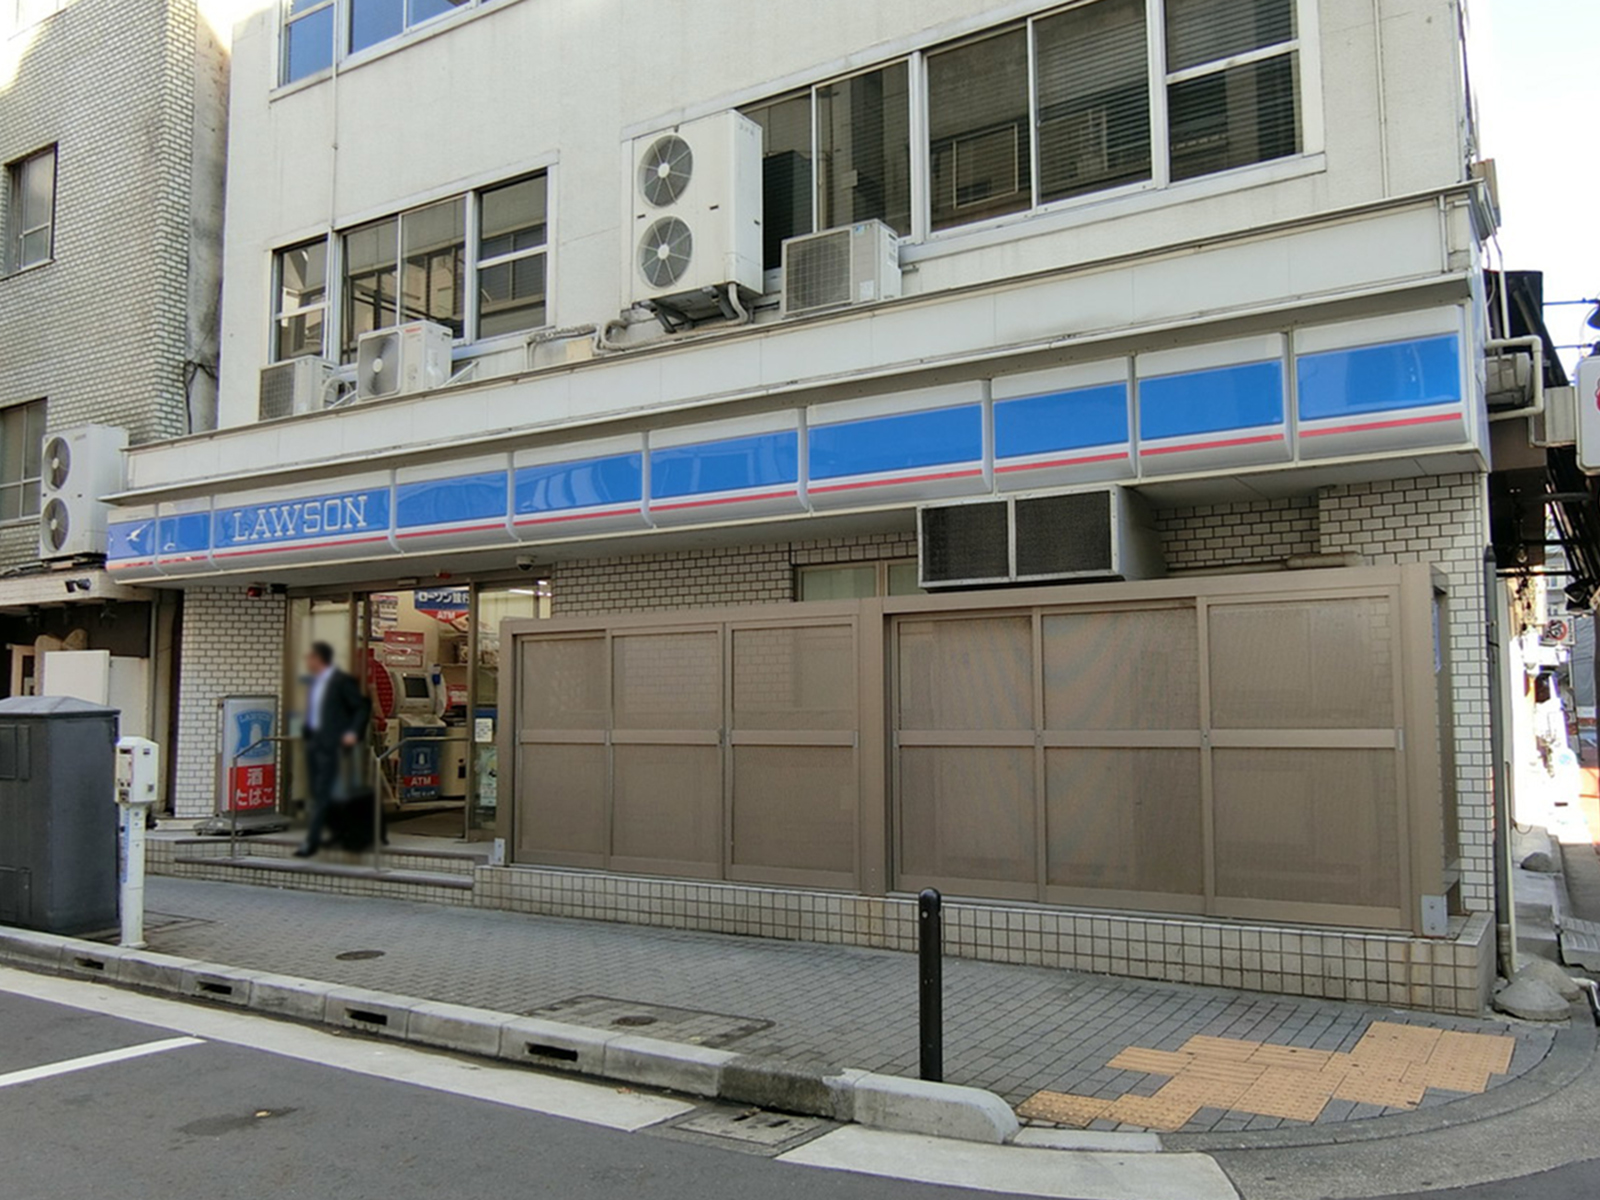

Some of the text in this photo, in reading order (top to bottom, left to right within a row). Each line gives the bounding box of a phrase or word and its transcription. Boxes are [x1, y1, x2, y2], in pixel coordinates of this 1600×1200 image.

[233, 496, 367, 541] LAWSON
[436, 610, 456, 619] ATM
[247, 767, 263, 786] 酒
[411, 776, 432, 786] ATM
